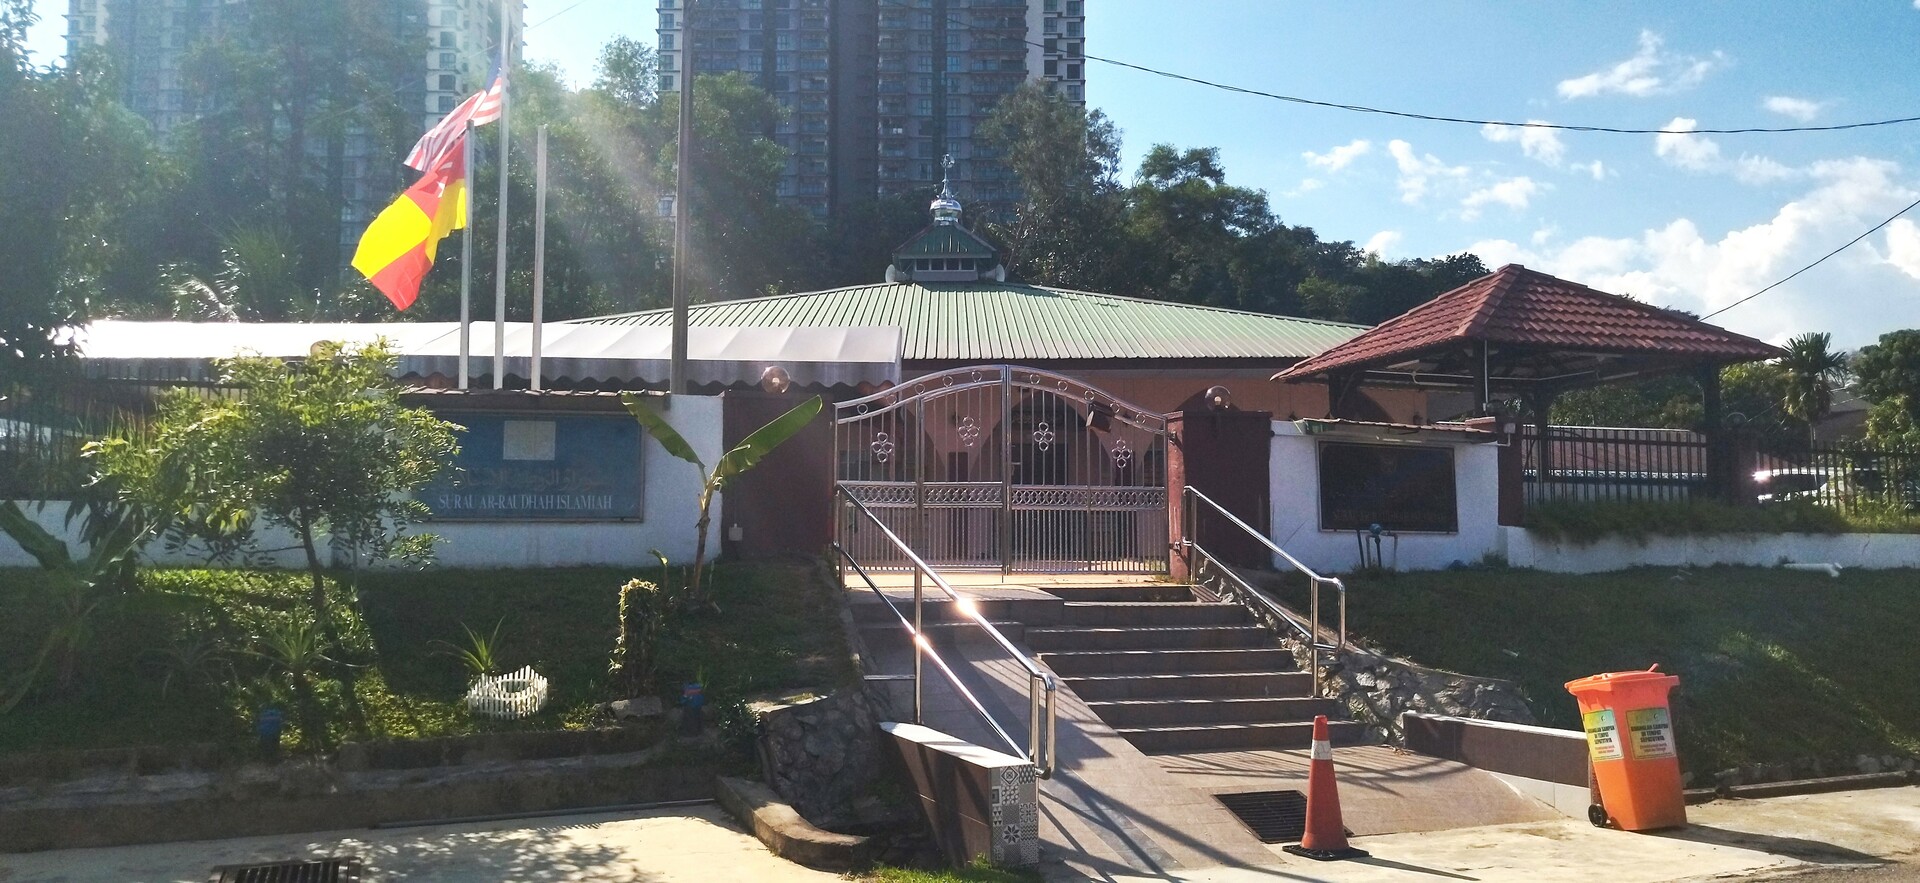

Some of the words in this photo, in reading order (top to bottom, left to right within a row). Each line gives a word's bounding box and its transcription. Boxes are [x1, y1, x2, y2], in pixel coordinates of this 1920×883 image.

[439, 494, 476, 509] SURAU
[479, 494, 554, 509] AR-RAUDHAH
[556, 494, 612, 509] ISLAMIAH
